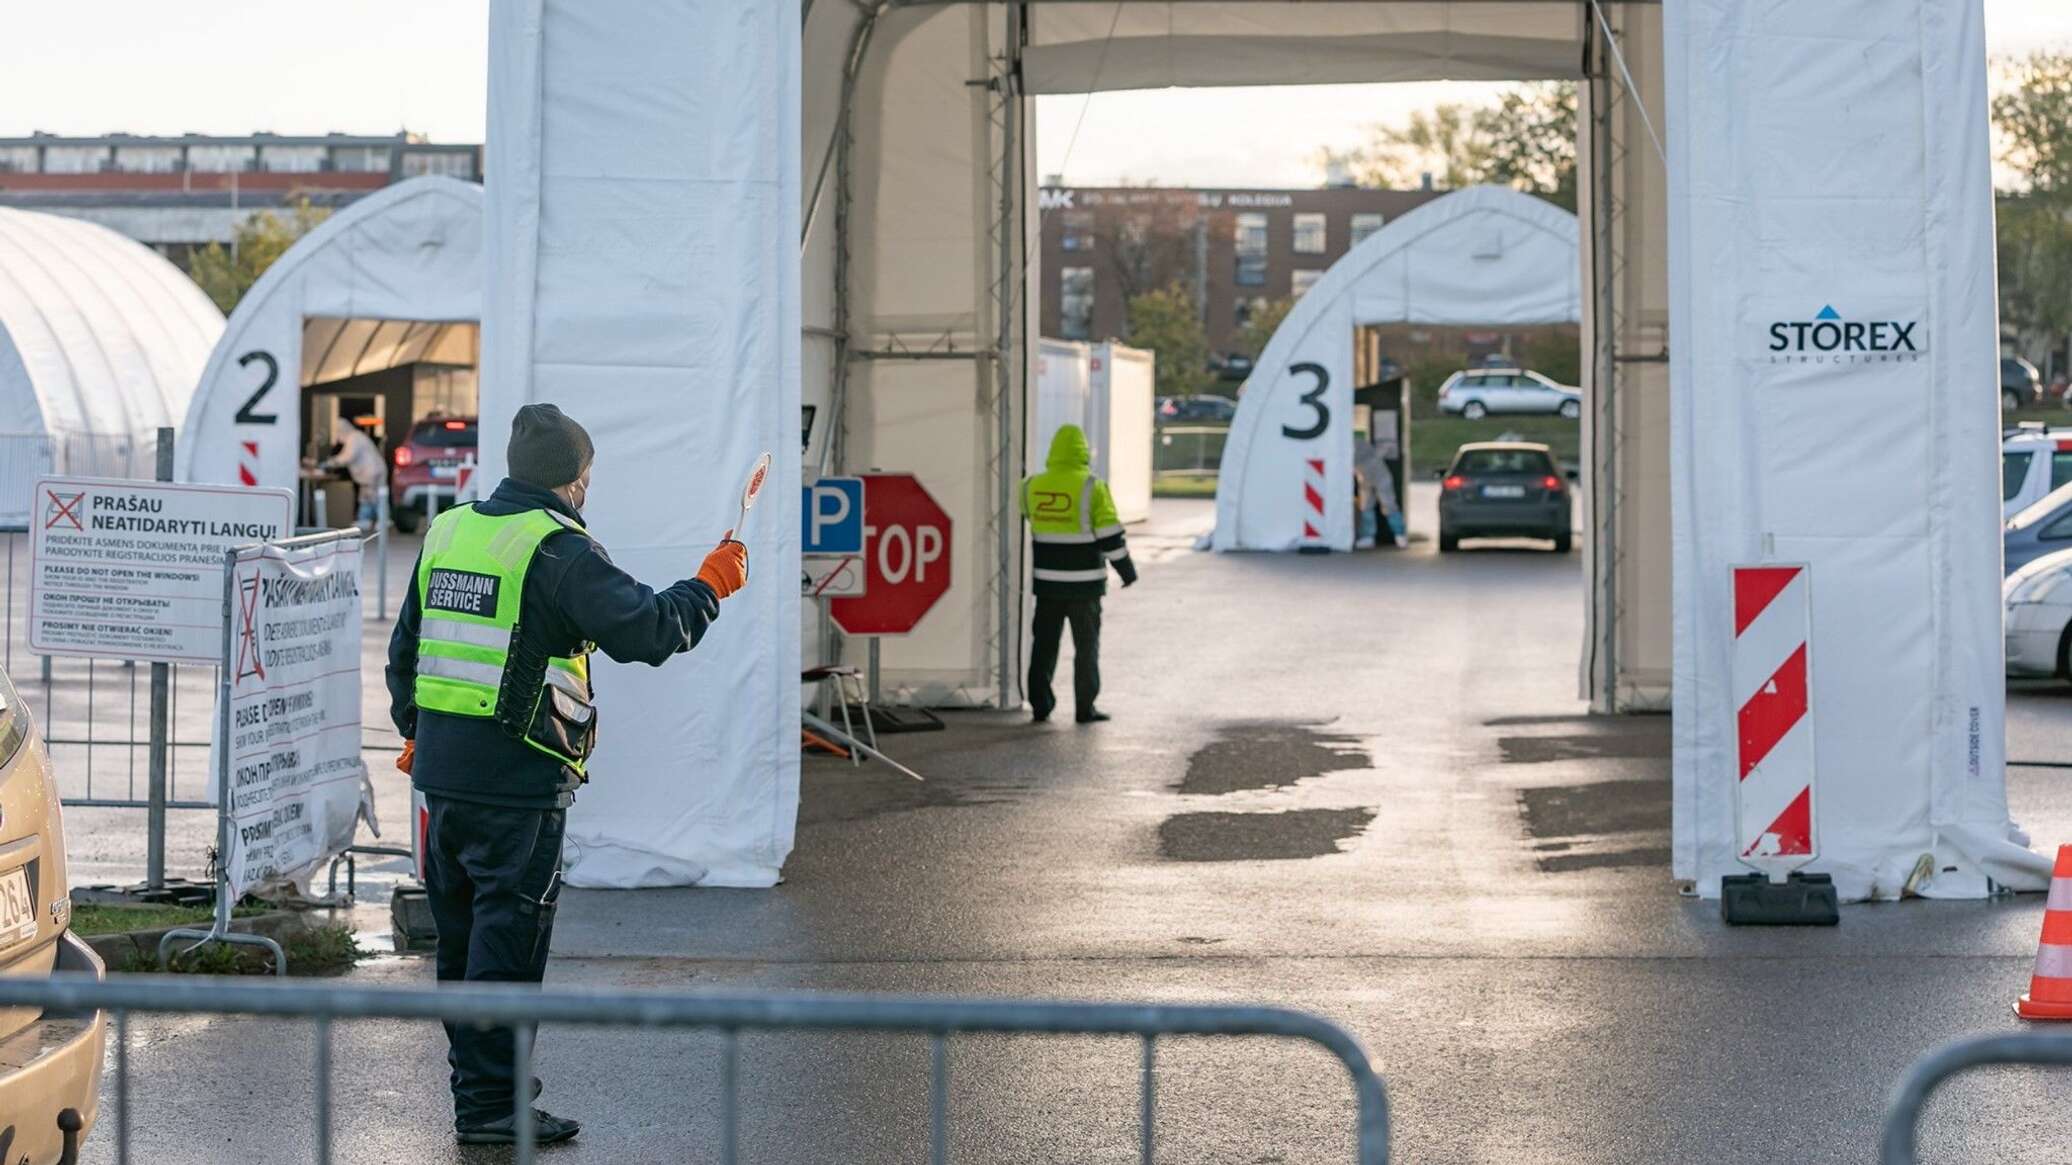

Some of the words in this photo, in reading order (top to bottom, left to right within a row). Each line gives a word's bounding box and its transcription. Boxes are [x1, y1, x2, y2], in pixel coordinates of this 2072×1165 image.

[1769, 321, 1917, 351] STOREX
[1769, 355, 1918, 364] STRUCTURES
[234, 351, 279, 424] 2
[1282, 362, 1331, 440] 3
[93, 494, 162, 513] PRAŠAU
[811, 487, 850, 545] P
[92, 515, 206, 535] NEATIDARYTI
[210, 521, 277, 542] LANGŲ!
[45, 546, 102, 558] PARODYKITE
[105, 550, 176, 562] REGISTRACIJOS
[95, 538, 134, 549] ASMENS
[864, 524, 943, 585] OP
[44, 565, 74, 574] PLEASE
[77, 567, 90, 575] DO
[91, 568, 109, 576] NOT
[111, 569, 134, 577] OPEN
[431, 589, 482, 611] SERVICE
[42, 621, 79, 630] PROSIMY
[97, 624, 142, 634] OTWIERAĆ
